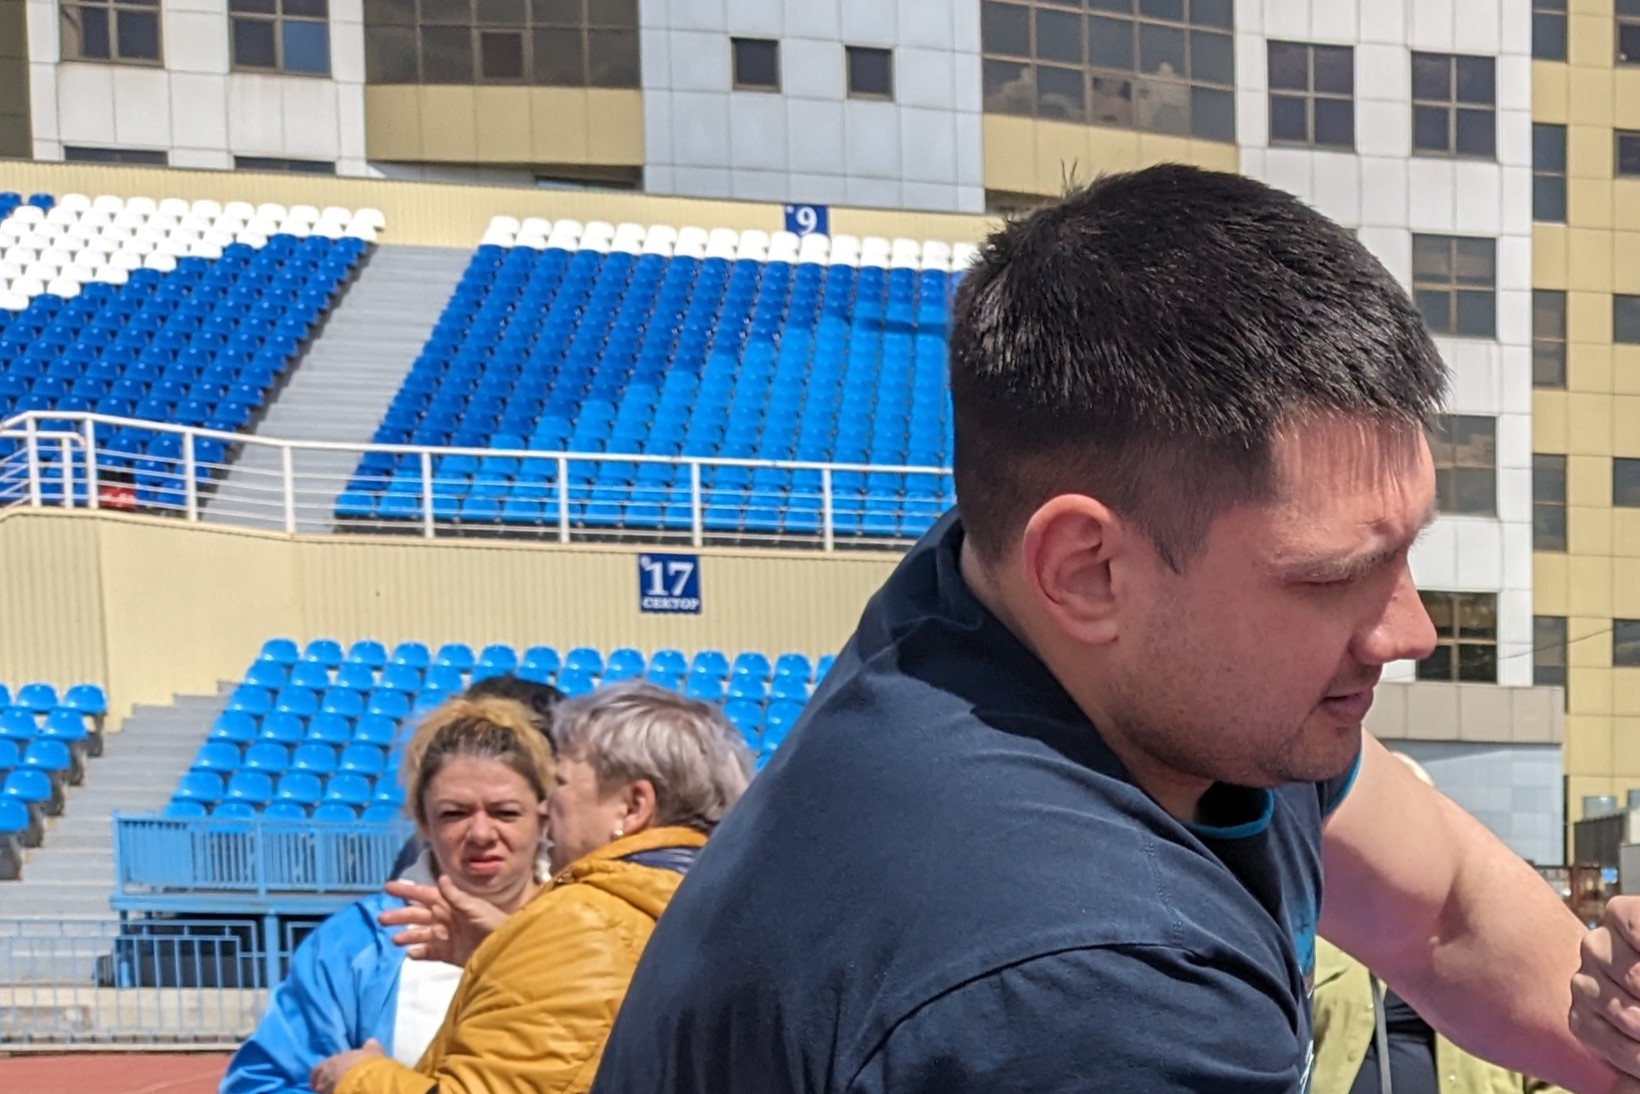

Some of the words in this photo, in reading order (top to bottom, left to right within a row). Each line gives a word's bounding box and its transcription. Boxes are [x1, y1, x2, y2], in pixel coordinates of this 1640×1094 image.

[796, 206, 818, 235] 9
[644, 561, 695, 597] 17
[642, 597, 700, 609] СЕКТОР
